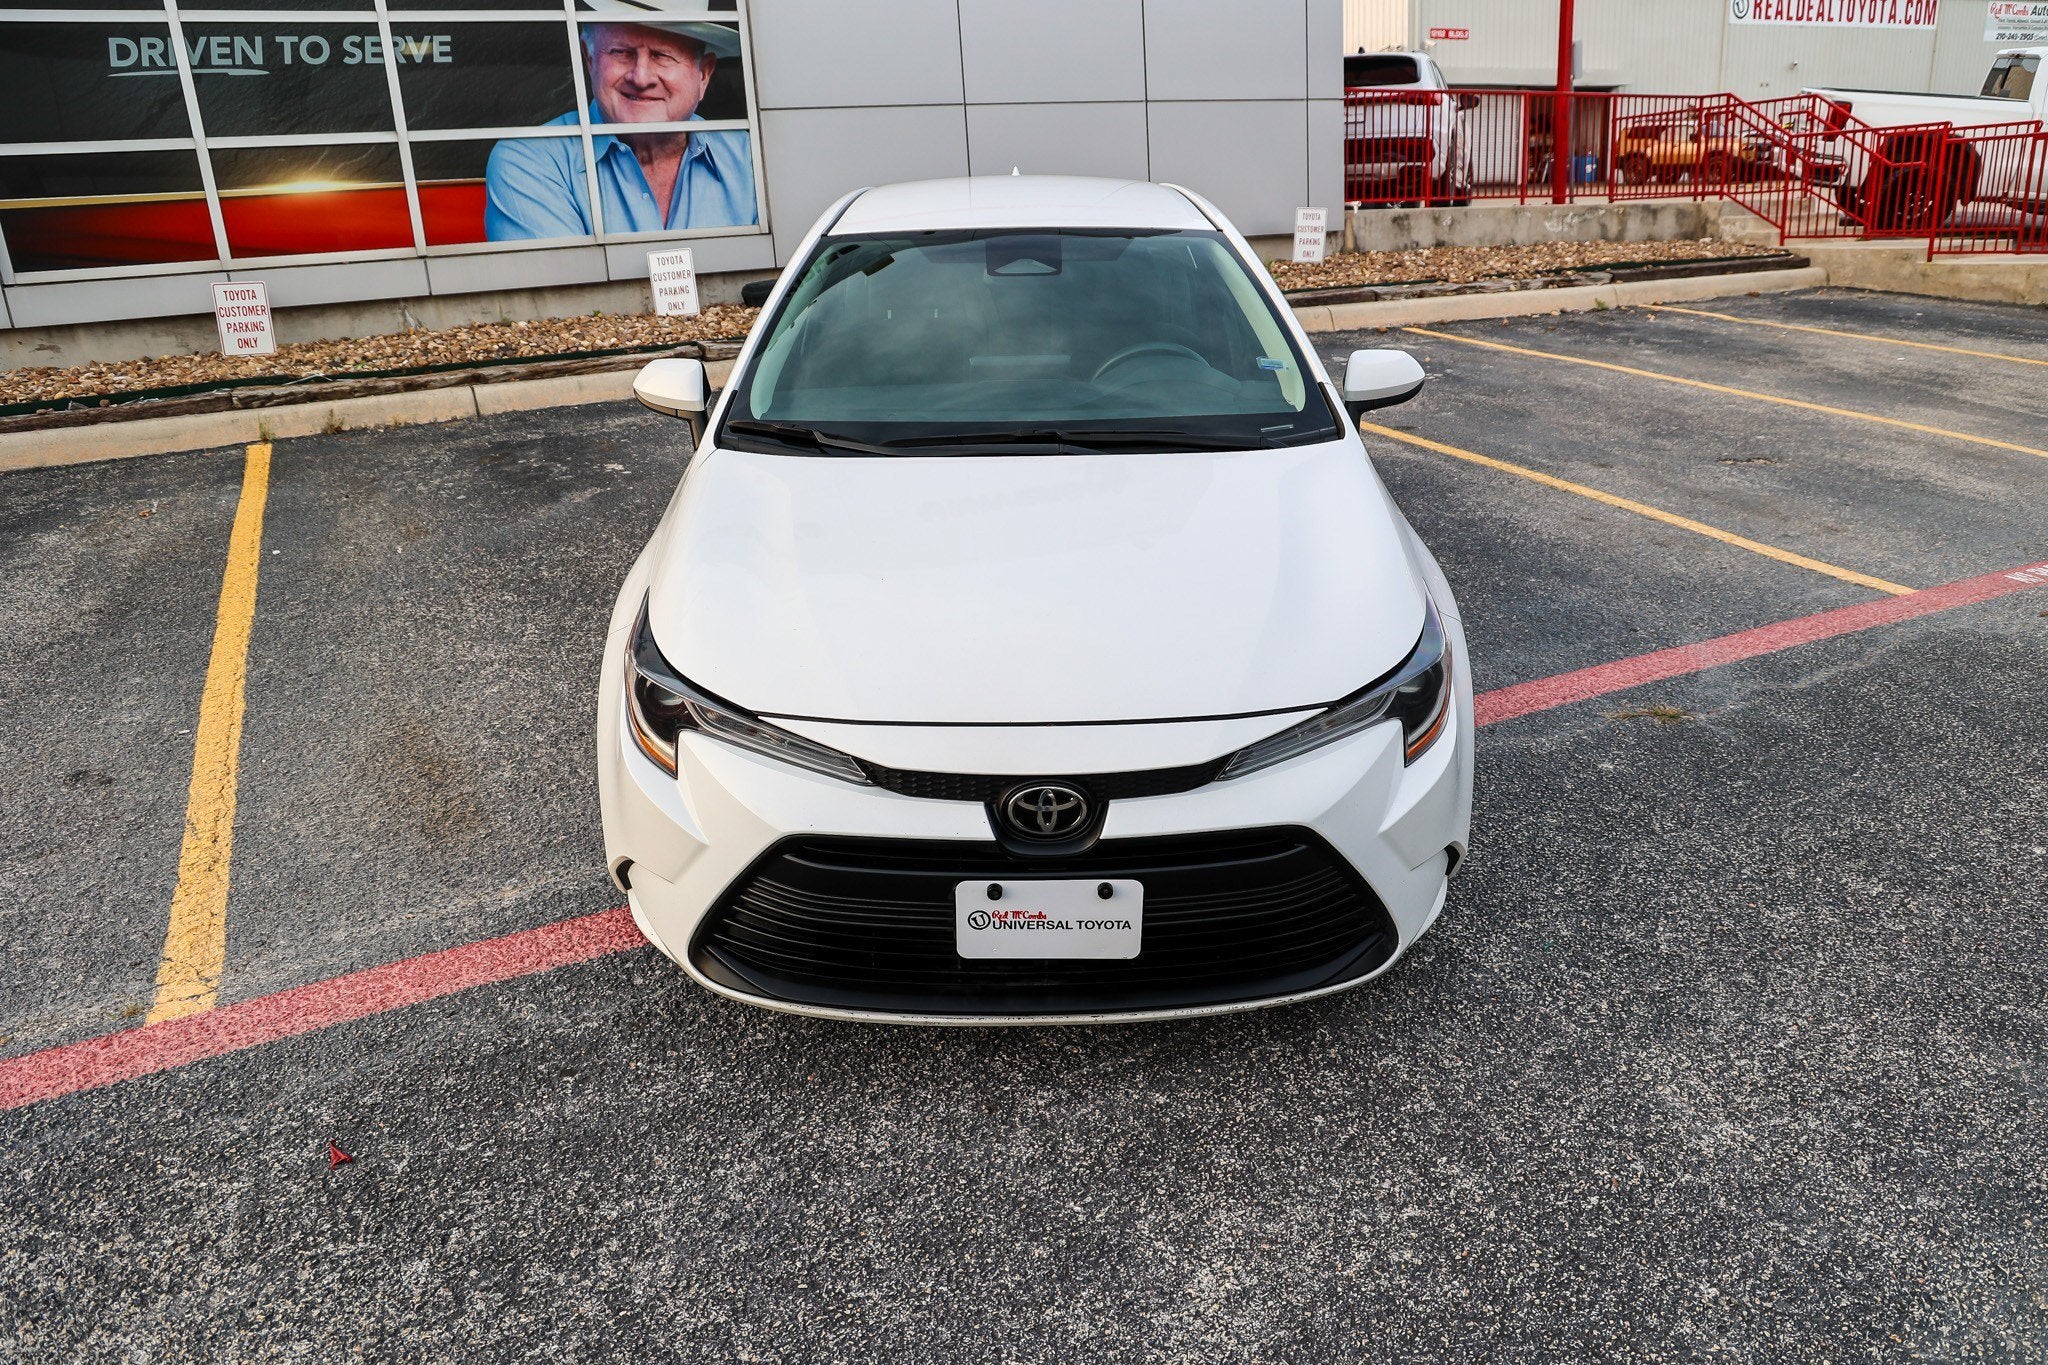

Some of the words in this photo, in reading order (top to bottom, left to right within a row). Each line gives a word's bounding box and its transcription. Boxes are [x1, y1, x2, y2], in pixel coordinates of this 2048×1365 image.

[1752, 0, 1936, 25] REALDEALTOYOTA.COM
[108, 36, 264, 68] DRIVEN
[275, 35, 330, 65] TO
[342, 35, 453, 65] SERVE
[657, 255, 684, 267] TOYOTA
[652, 269, 692, 283] CUSTOMER
[223, 289, 257, 301] TOYOTA
[658, 285, 690, 297] PARKING
[218, 304, 267, 318] CUSTOMER
[667, 301, 685, 311] ONLY
[226, 320, 265, 334] PARKING
[237, 337, 258, 349] ONLY
[991, 910, 1009, 922] Red
[1010, 910, 1047, 920] McCombs
[992, 920, 1073, 930] UNIVERSAL
[1076, 920, 1131, 930] TOYOTA
